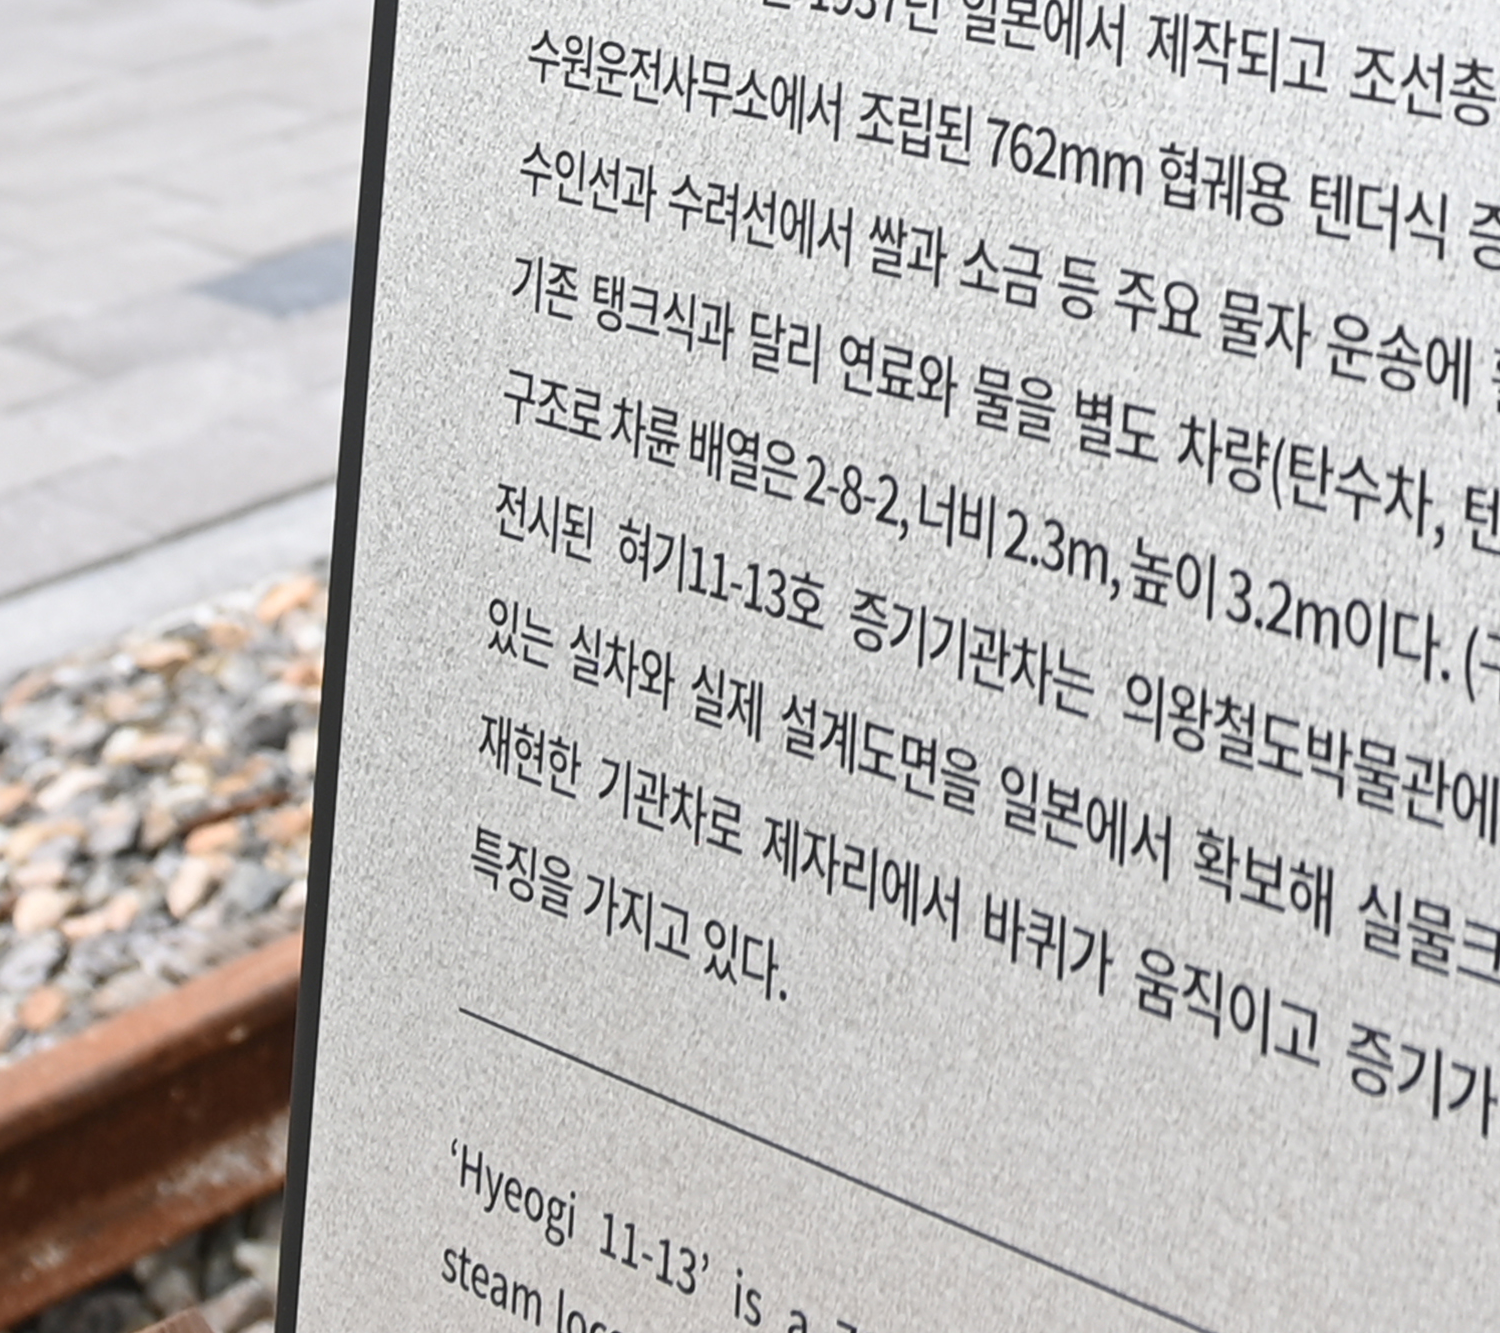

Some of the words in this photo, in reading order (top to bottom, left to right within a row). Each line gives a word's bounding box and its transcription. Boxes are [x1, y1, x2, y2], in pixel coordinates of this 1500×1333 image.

[527, 29, 844, 143] 수원운전사무소에서
[855, 90, 974, 168] 조립된
[986, 115, 1145, 197] 762mm
[1158, 141, 1291, 229] 협궤용
[1308, 173, 1449, 262] 텐더식
[1145, 12, 1329, 94] 제작되고
[510, 256, 579, 322] 기존
[591, 273, 736, 362] 탱크식과
[749, 310, 823, 385] 달리
[838, 333, 959, 419] 연료와
[972, 363, 1057, 444] 물을
[1074, 388, 1160, 464] 별도
[1176, 414, 1446, 551] 차량(탄수차,
[519, 141, 658, 223] 수인선과
[667, 174, 855, 269] 수려선에서
[868, 214, 949, 289] 쌀과
[958, 237, 1044, 310] 소금
[1057, 254, 1101, 322] 등
[1113, 267, 1202, 340] 주요
[1218, 288, 1313, 371] 물자
[1326, 312, 1474, 409] 운송에
[503, 367, 603, 442] 구조로
[609, 396, 681, 469] 차륜
[688, 419, 799, 502] 배열은
[802, 453, 911, 542] 2-8-2,
[917, 483, 998, 560] 너비
[1003, 507, 1122, 602] 2.3m,
[1129, 535, 1218, 622] 높이
[1224, 567, 1452, 684] 3.2m이다.
[486, 597, 555, 670] 있는
[568, 624, 677, 712] 실차와
[690, 664, 765, 744] 실제
[780, 693, 981, 817] 설계도면을
[999, 764, 1174, 883] 일본에서
[1193, 826, 1336, 938] 확보해
[494, 482, 595, 565] 전시된
[618, 517, 825, 632] 혀기11-13호
[849, 588, 1095, 720] 증기기관차는
[1122, 672, 1500, 847] 의왕철도박물관에
[470, 825, 574, 920] 특징을
[582, 873, 691, 961] 가지고
[703, 918, 788, 1002] 있다.
[477, 713, 583, 800] 재현한
[597, 756, 744, 856] 기관차로
[761, 815, 962, 943] 제자리에서
[982, 892, 1115, 997] 바퀴가
[1134, 946, 1321, 1068] 움직이고
[1345, 1021, 1499, 1139] 증기가
[440, 1245, 543, 1326] steam
[733, 1267, 763, 1327] is
